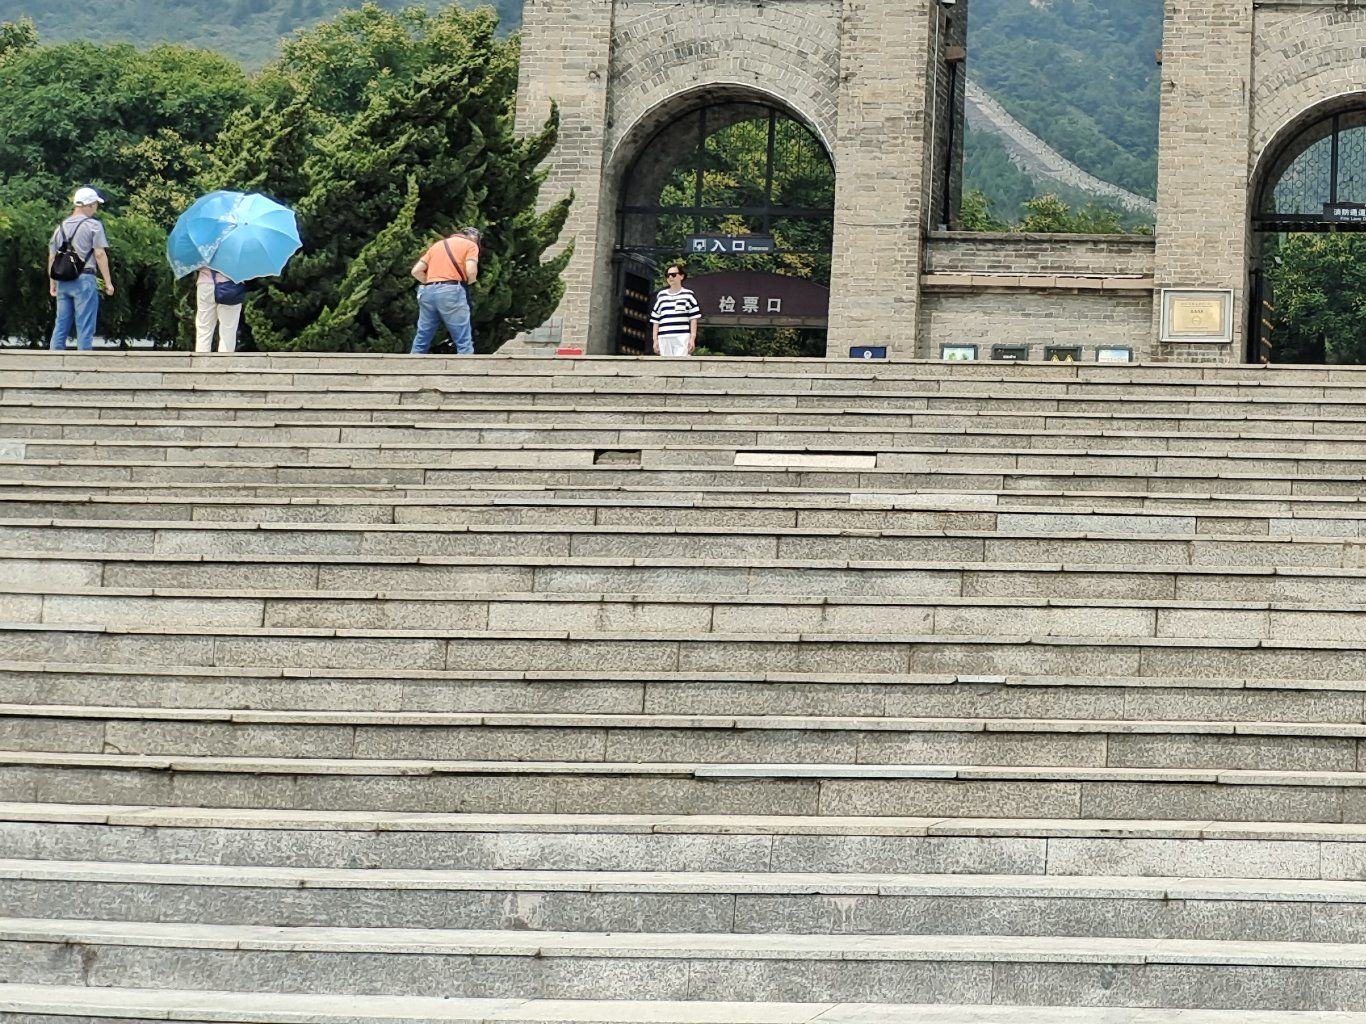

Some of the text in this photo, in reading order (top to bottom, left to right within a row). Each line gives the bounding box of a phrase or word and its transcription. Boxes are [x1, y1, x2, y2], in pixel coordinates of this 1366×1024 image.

[710, 239, 745, 252] 入口
[719, 295, 781, 313] 检票口
